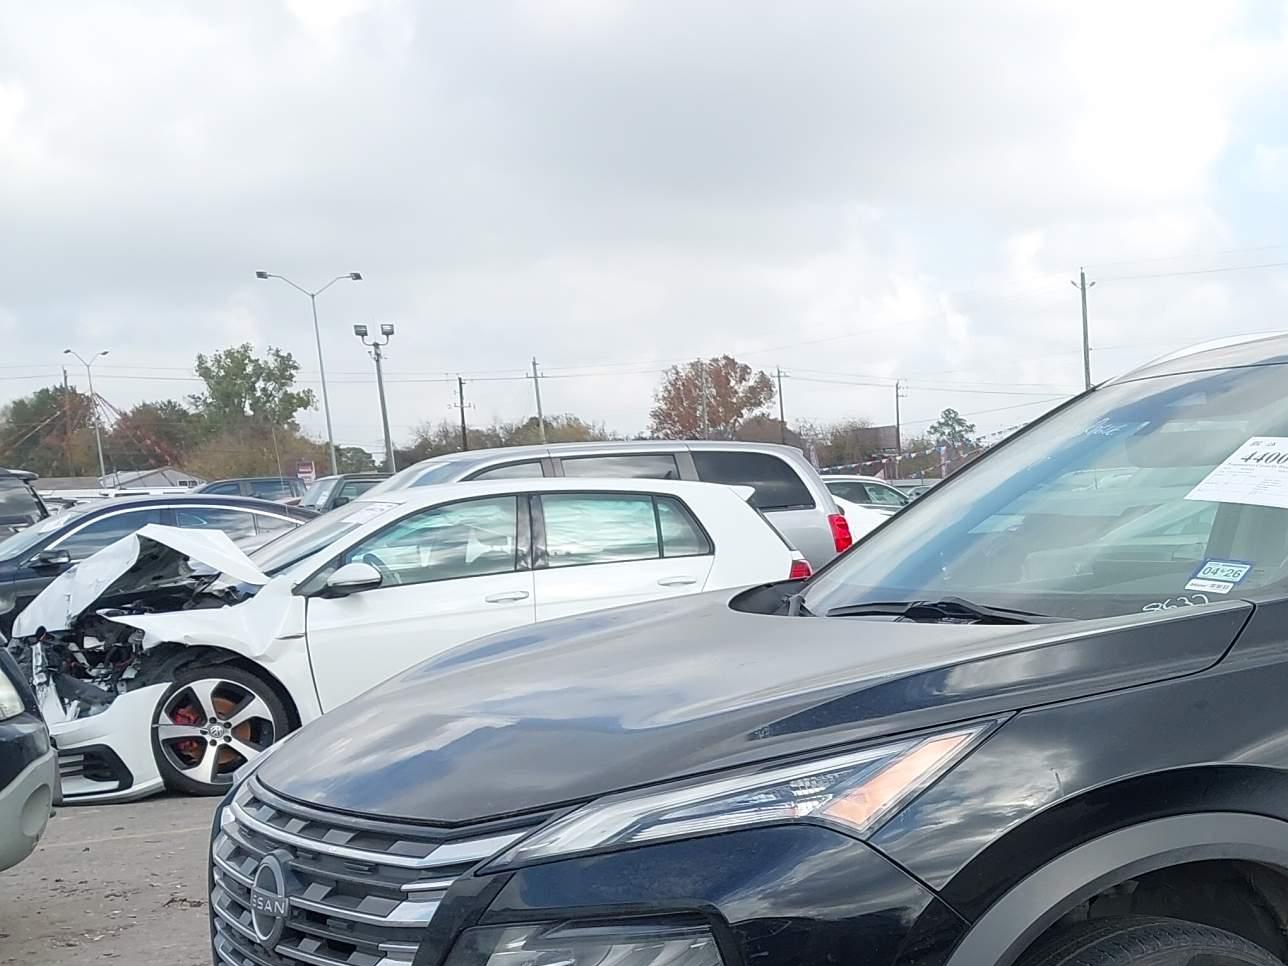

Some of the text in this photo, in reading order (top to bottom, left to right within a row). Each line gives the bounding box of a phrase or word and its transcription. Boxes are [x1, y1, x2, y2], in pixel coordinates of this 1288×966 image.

[1202, 566, 1241, 578] 04 26
[252, 895, 285, 914] SSAN
